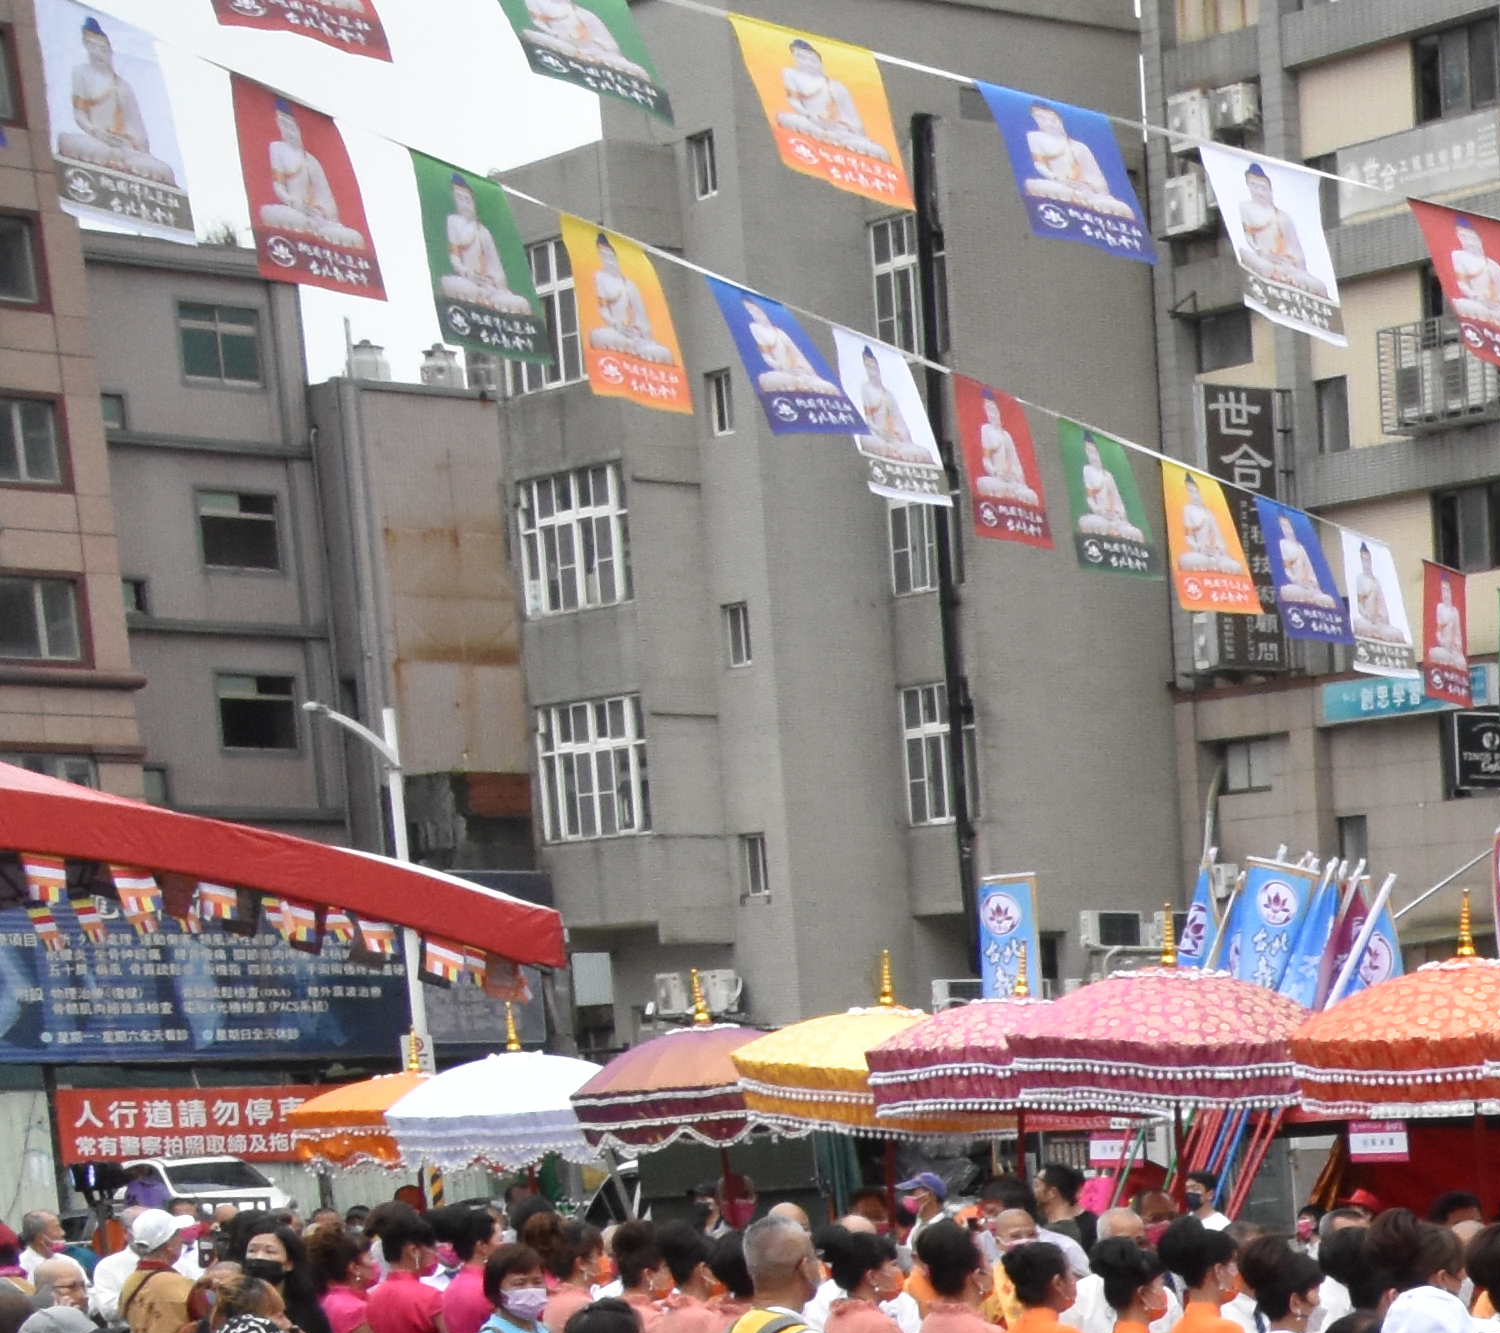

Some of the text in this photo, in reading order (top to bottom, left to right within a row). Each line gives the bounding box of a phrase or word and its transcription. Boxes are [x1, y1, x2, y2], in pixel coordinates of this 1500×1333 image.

[1208, 390, 1273, 490] 世合
[75, 1098, 305, 1130] 人行道請勿停車
